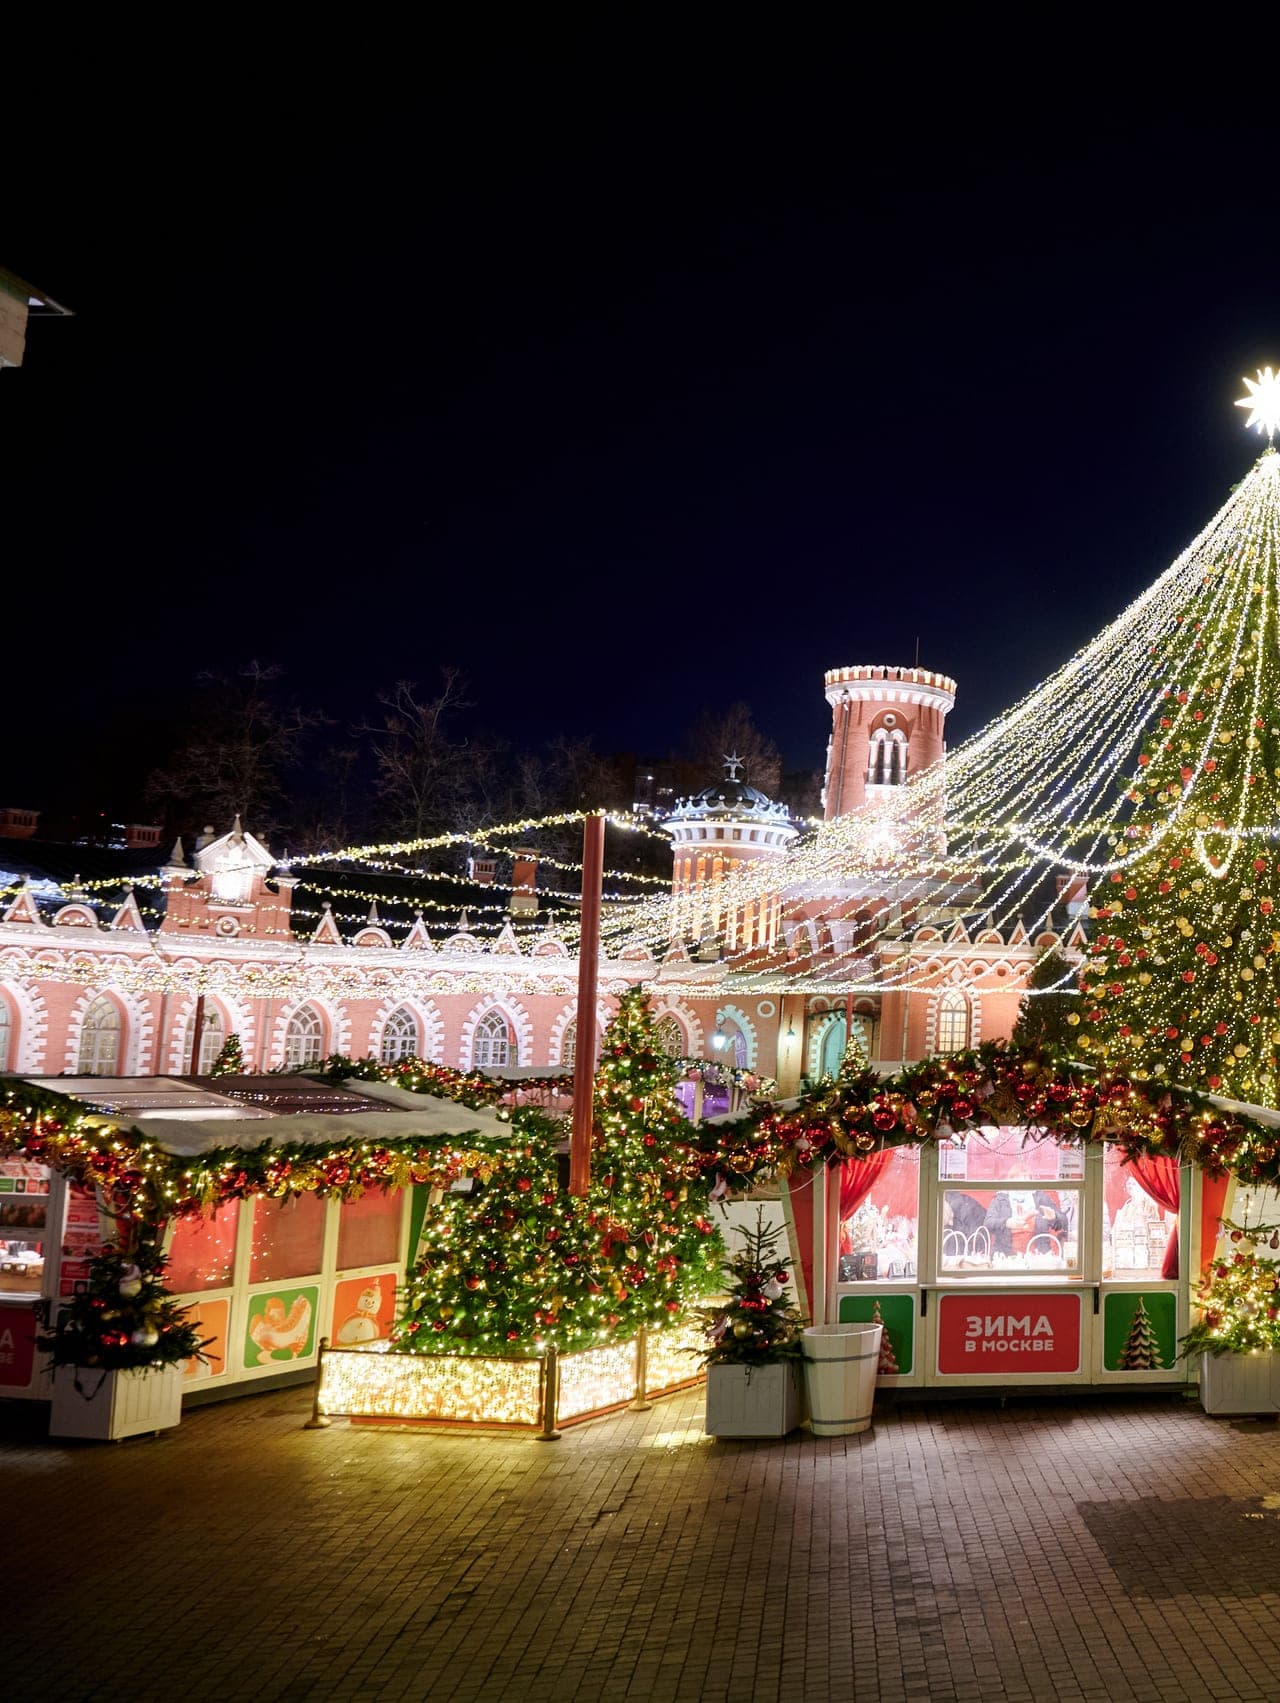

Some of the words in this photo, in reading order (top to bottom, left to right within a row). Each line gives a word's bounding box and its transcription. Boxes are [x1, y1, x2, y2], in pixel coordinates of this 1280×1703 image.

[965, 1315, 1054, 1337] ЗИМА
[965, 1340, 976, 1352] В
[982, 1340, 1054, 1352] МОСКВЕ
